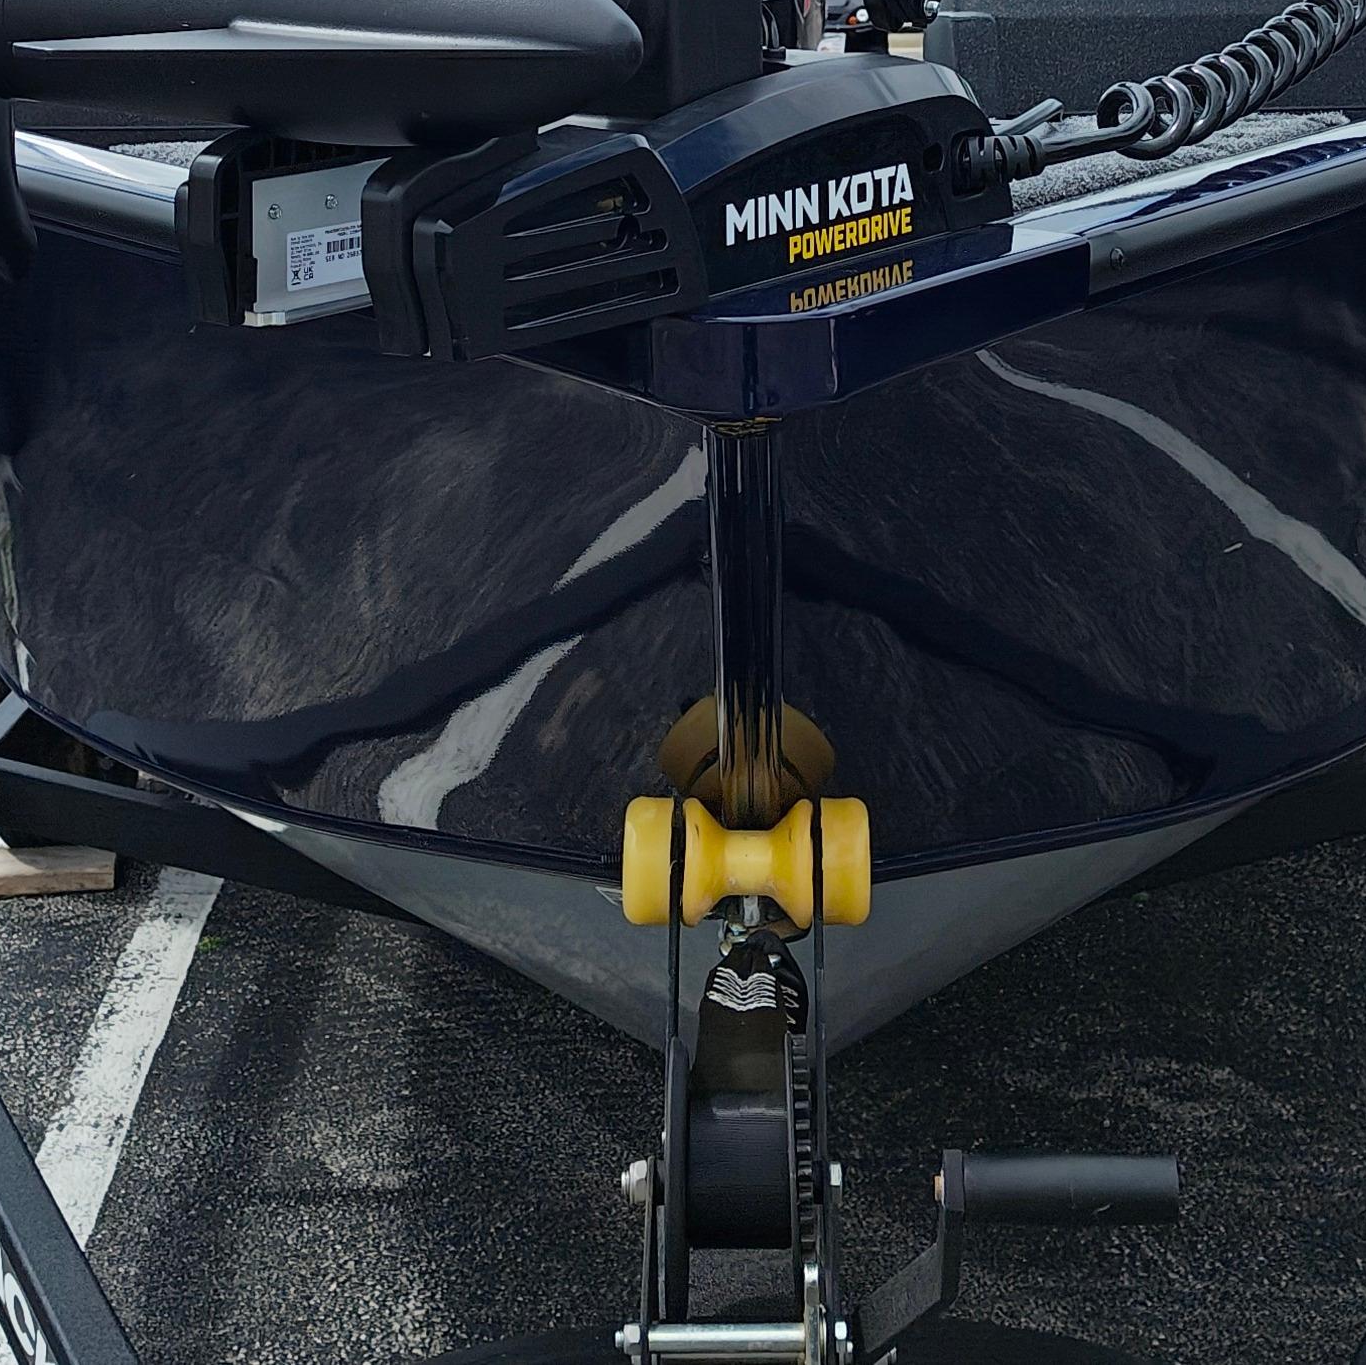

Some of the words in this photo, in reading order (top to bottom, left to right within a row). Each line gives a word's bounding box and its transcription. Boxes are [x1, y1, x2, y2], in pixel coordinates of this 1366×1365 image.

[726, 183, 819, 247] MINN
[828, 163, 914, 221] KOTA
[789, 206, 913, 264] POWERDRIVE
